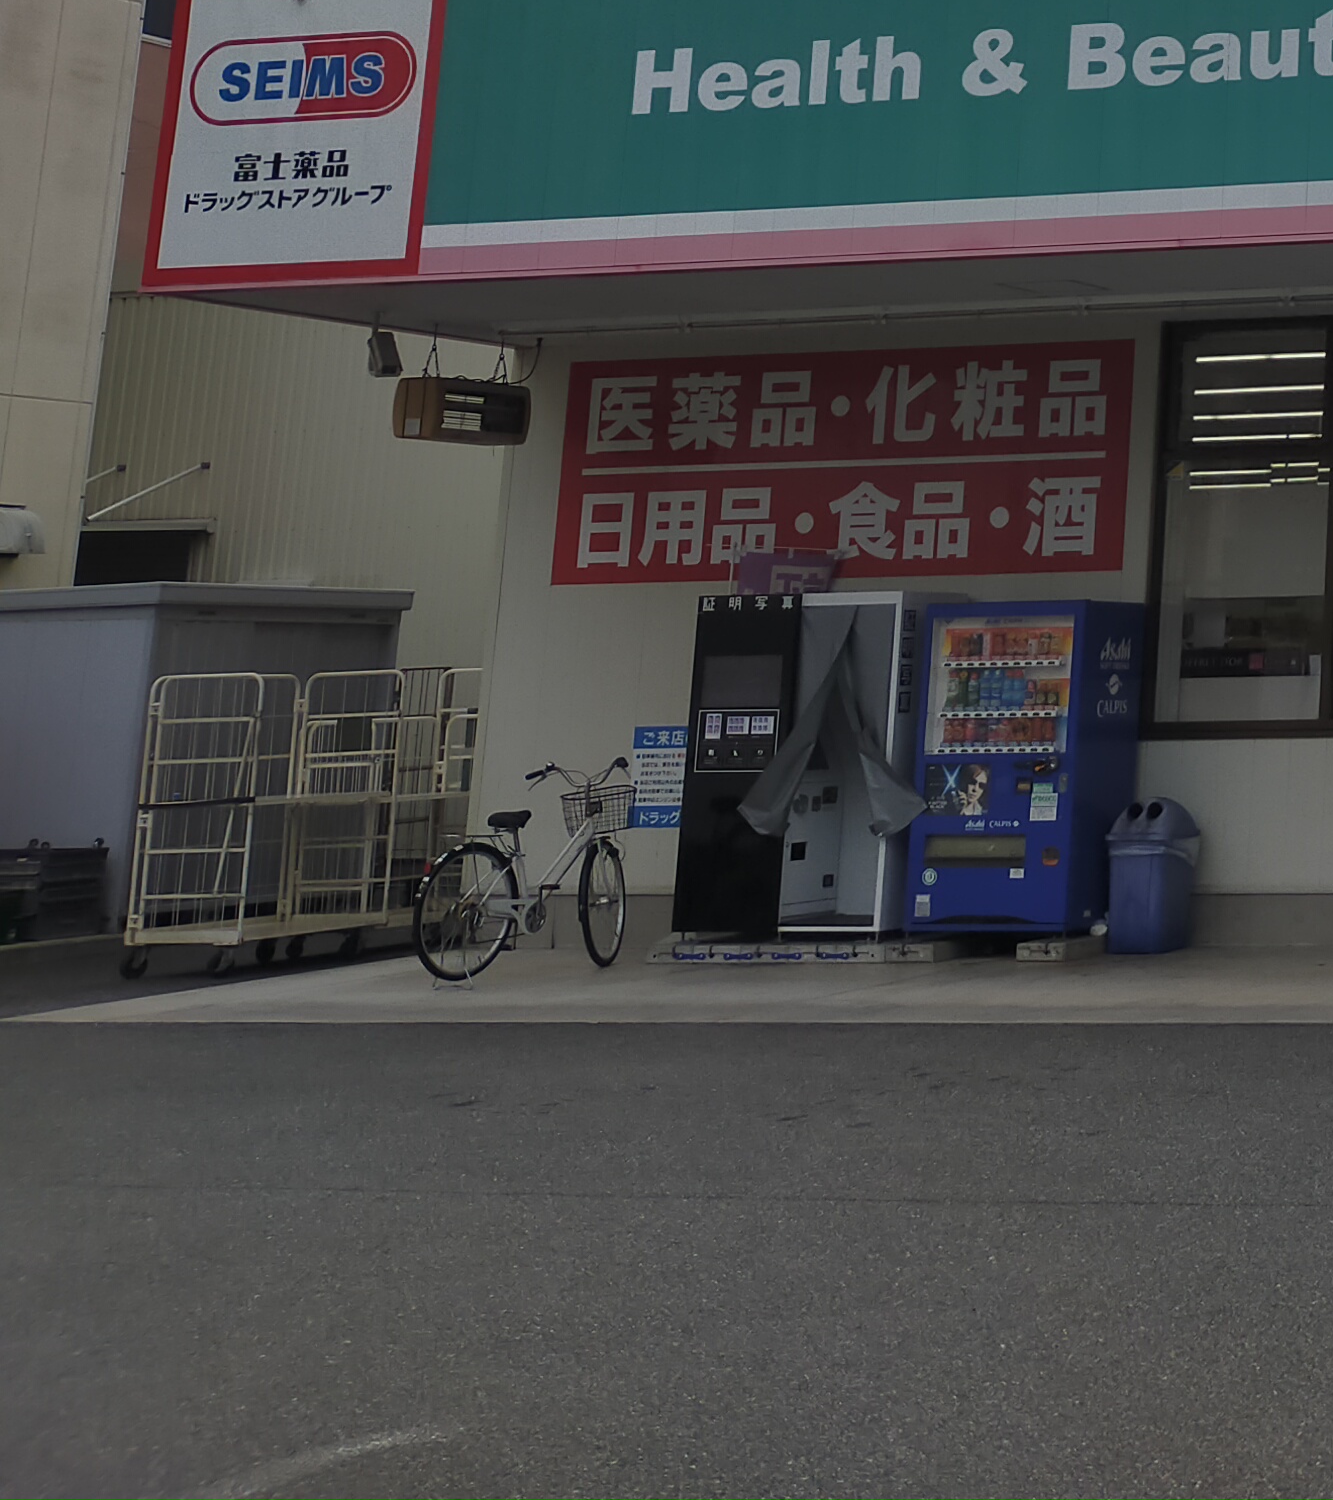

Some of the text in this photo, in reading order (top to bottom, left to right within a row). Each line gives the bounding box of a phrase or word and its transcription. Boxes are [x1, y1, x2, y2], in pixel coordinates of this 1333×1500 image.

[218, 52, 385, 102] SEIMS
[631, 35, 922, 115] Health
[962, 29, 1028, 97] &
[233, 148, 349, 183] 富士薬品
[184, 184, 393, 214] ドラッグストアグループ
[585, 358, 1107, 455] 医薬品・化粧品
[576, 475, 1102, 569] 日用品・食品・酒
[702, 596, 795, 612] 証明写真
[1100, 636, 1132, 661] Asahi
[1097, 699, 1129, 718] CALPIS
[643, 730, 688, 746] ご来店
